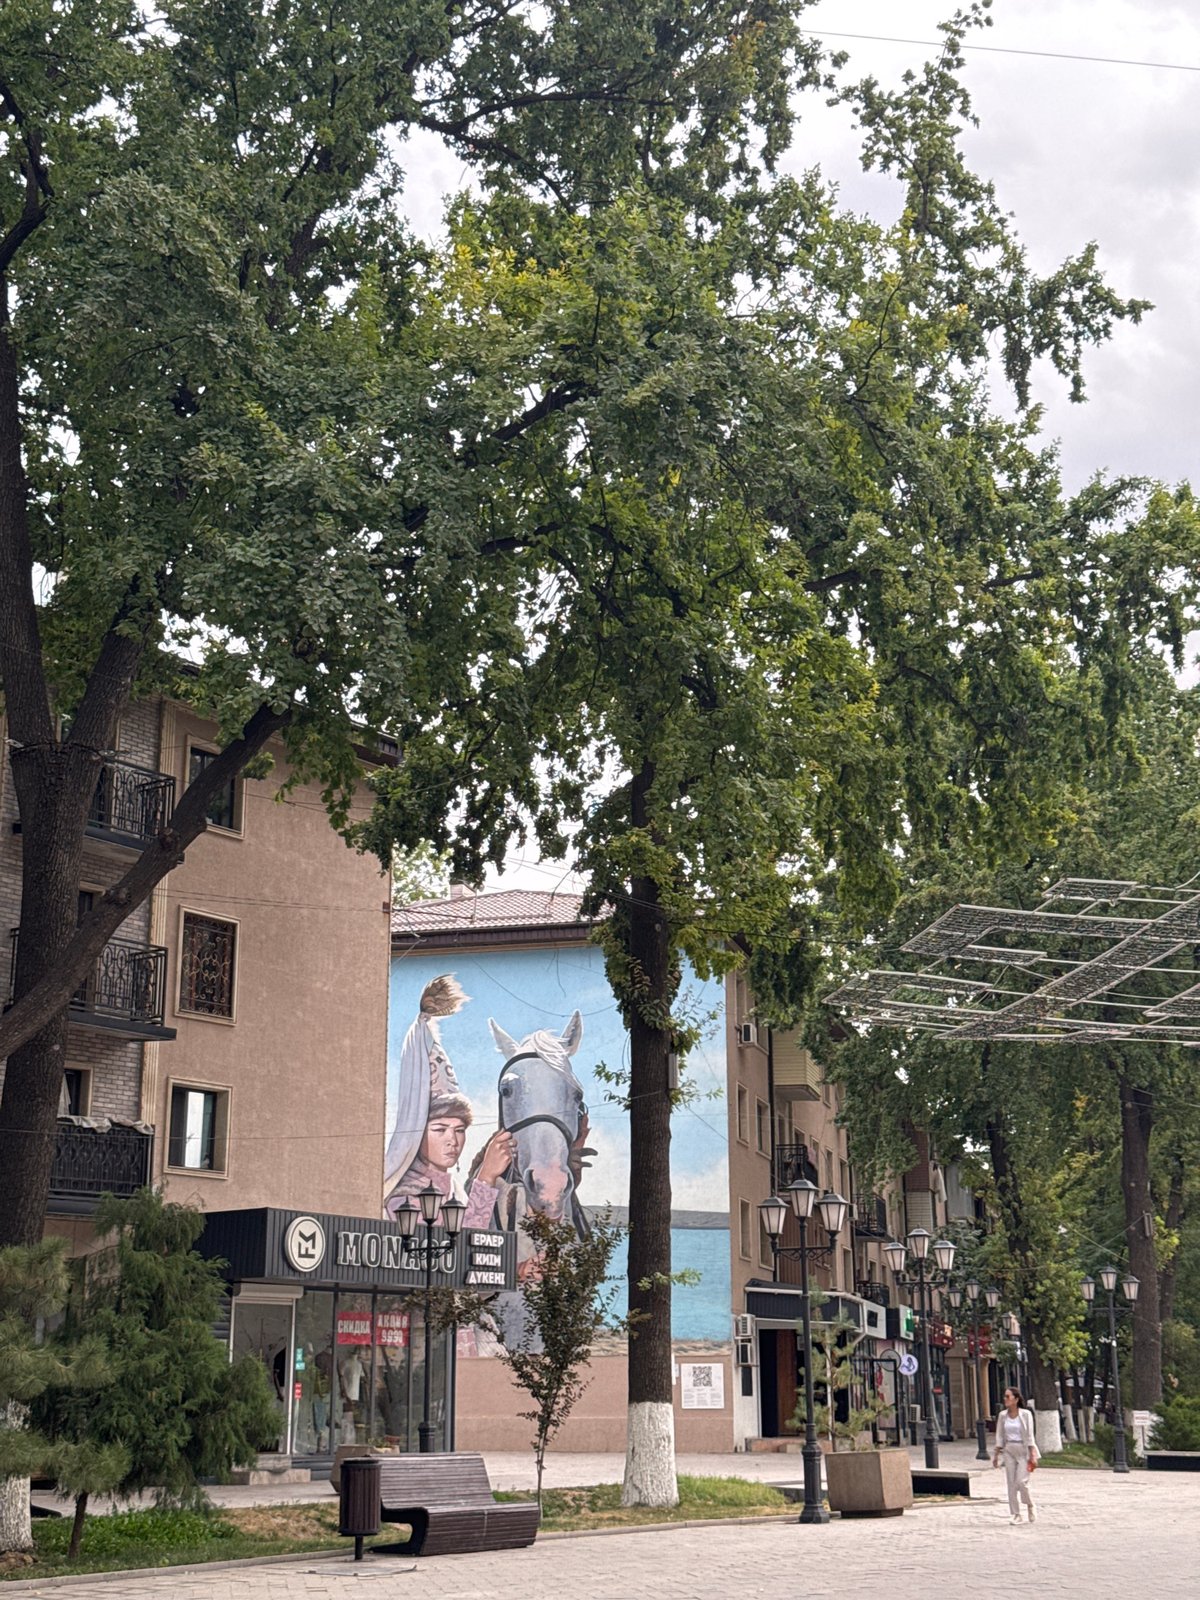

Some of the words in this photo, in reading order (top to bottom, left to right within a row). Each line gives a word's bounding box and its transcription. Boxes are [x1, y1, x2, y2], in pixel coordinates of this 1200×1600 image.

[471, 1232, 505, 1248] ЕРЛЕР
[338, 1231, 457, 1274] MONACO
[473, 1252, 502, 1267] КИІМ
[337, 1319, 371, 1336] СКИДКА
[377, 1314, 408, 1330] АКЦИЯ
